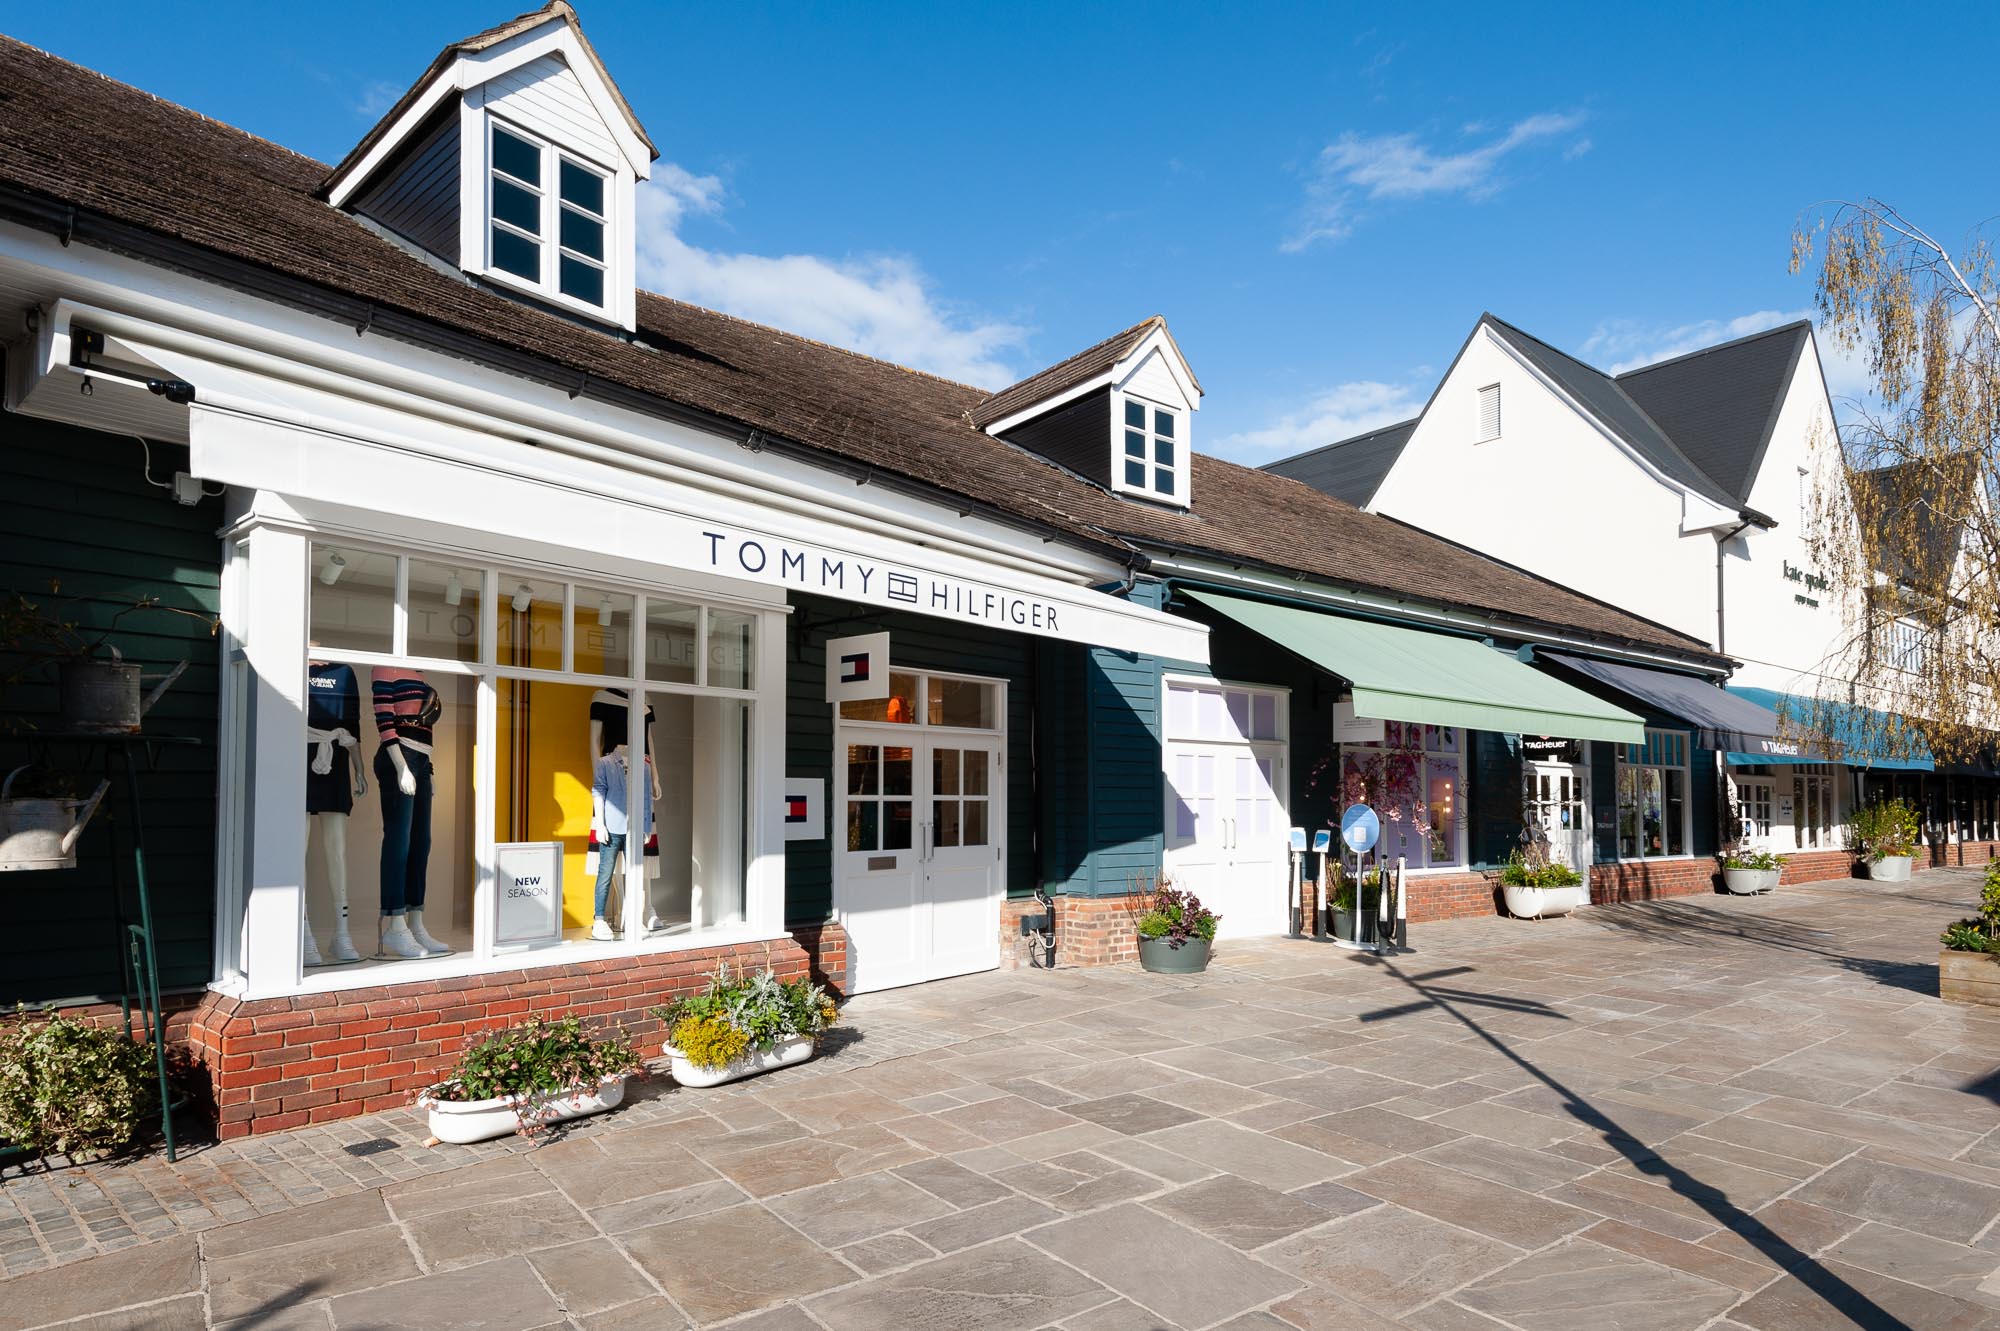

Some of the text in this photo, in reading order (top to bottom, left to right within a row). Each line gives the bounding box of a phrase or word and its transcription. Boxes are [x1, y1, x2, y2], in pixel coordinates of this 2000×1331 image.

[702, 532, 1060, 632] TOMMY HILFIGER
[515, 876, 541, 886] NEW
[507, 887, 548, 898] SEASON
